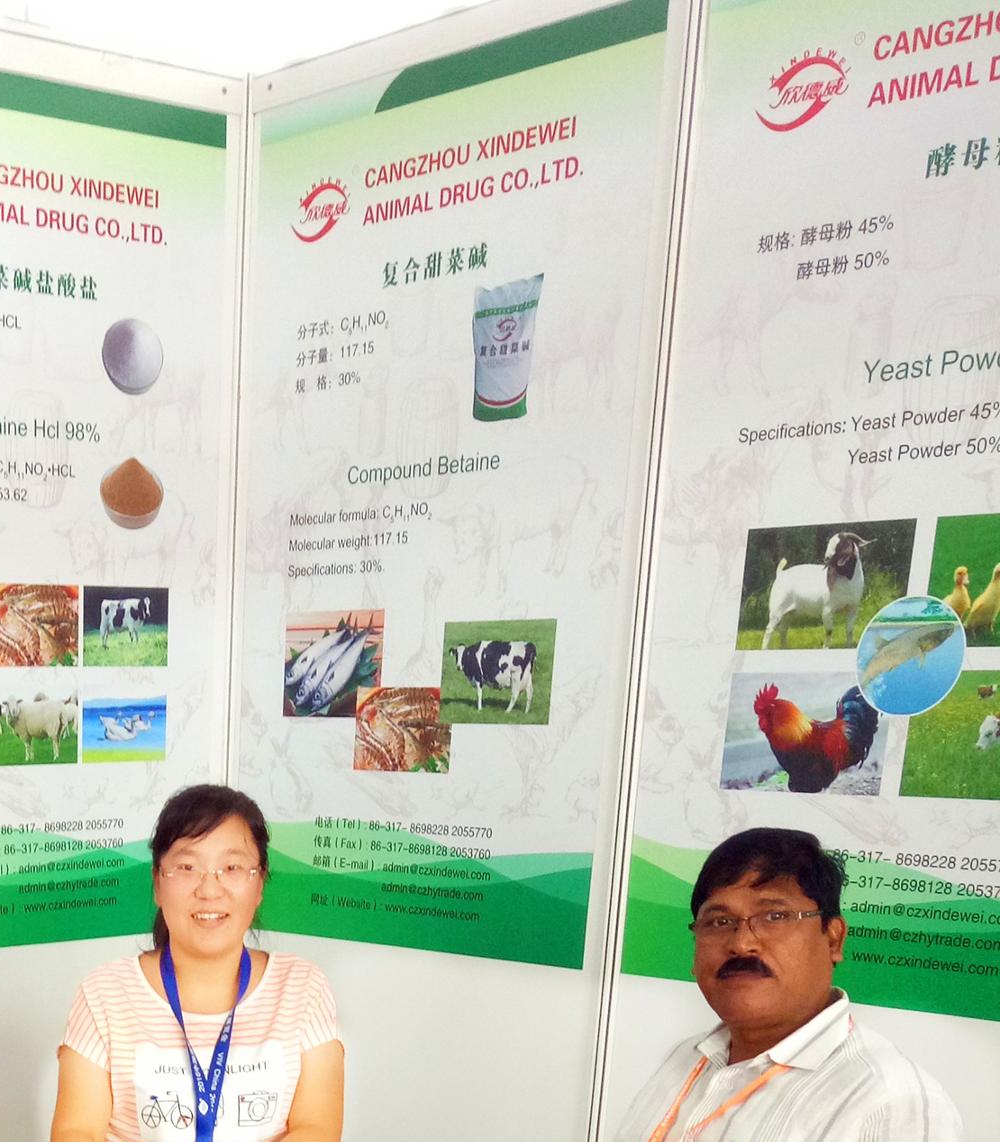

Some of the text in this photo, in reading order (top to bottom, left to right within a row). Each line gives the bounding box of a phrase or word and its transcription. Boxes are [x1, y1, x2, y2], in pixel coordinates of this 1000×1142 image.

[867, 61, 980, 109] ANIMAL
[364, 116, 577, 189] CANGZHOU XINDEWEI
[70, 174, 160, 209] XINDEWEI
[362, 156, 584, 226] ANIMAL DRUG CO.,LTD.
[36, 208, 89, 234] DRUG
[95, 217, 168, 246] CO.,LTD.
[858, 214, 894, 236] 45%
[382, 242, 489, 289] 复合甜菜碱
[796, 250, 890, 280] 酵母粉 50%
[338, 371, 361, 387] 30%
[863, 353, 933, 384] Yeast
[65, 422, 101, 443] 98%
[738, 407, 965, 446] Specifications: Yeast Powder
[848, 447, 892, 465] Yeast
[897, 440, 962, 461] Powder
[347, 451, 501, 485] Compound Betaine
[289, 505, 379, 527] Molecular formula:
[289, 537, 335, 552] Molecular
[288, 563, 357, 580] Specifications:
[44, 818, 124, 832] 8698228 2055770
[409, 821, 493, 839] 8698228 2055770
[85, 837, 124, 849] 2053760
[450, 845, 491, 860] 2053760
[896, 852, 956, 870] 8698228
[155, 1064, 185, 1075] JUST
